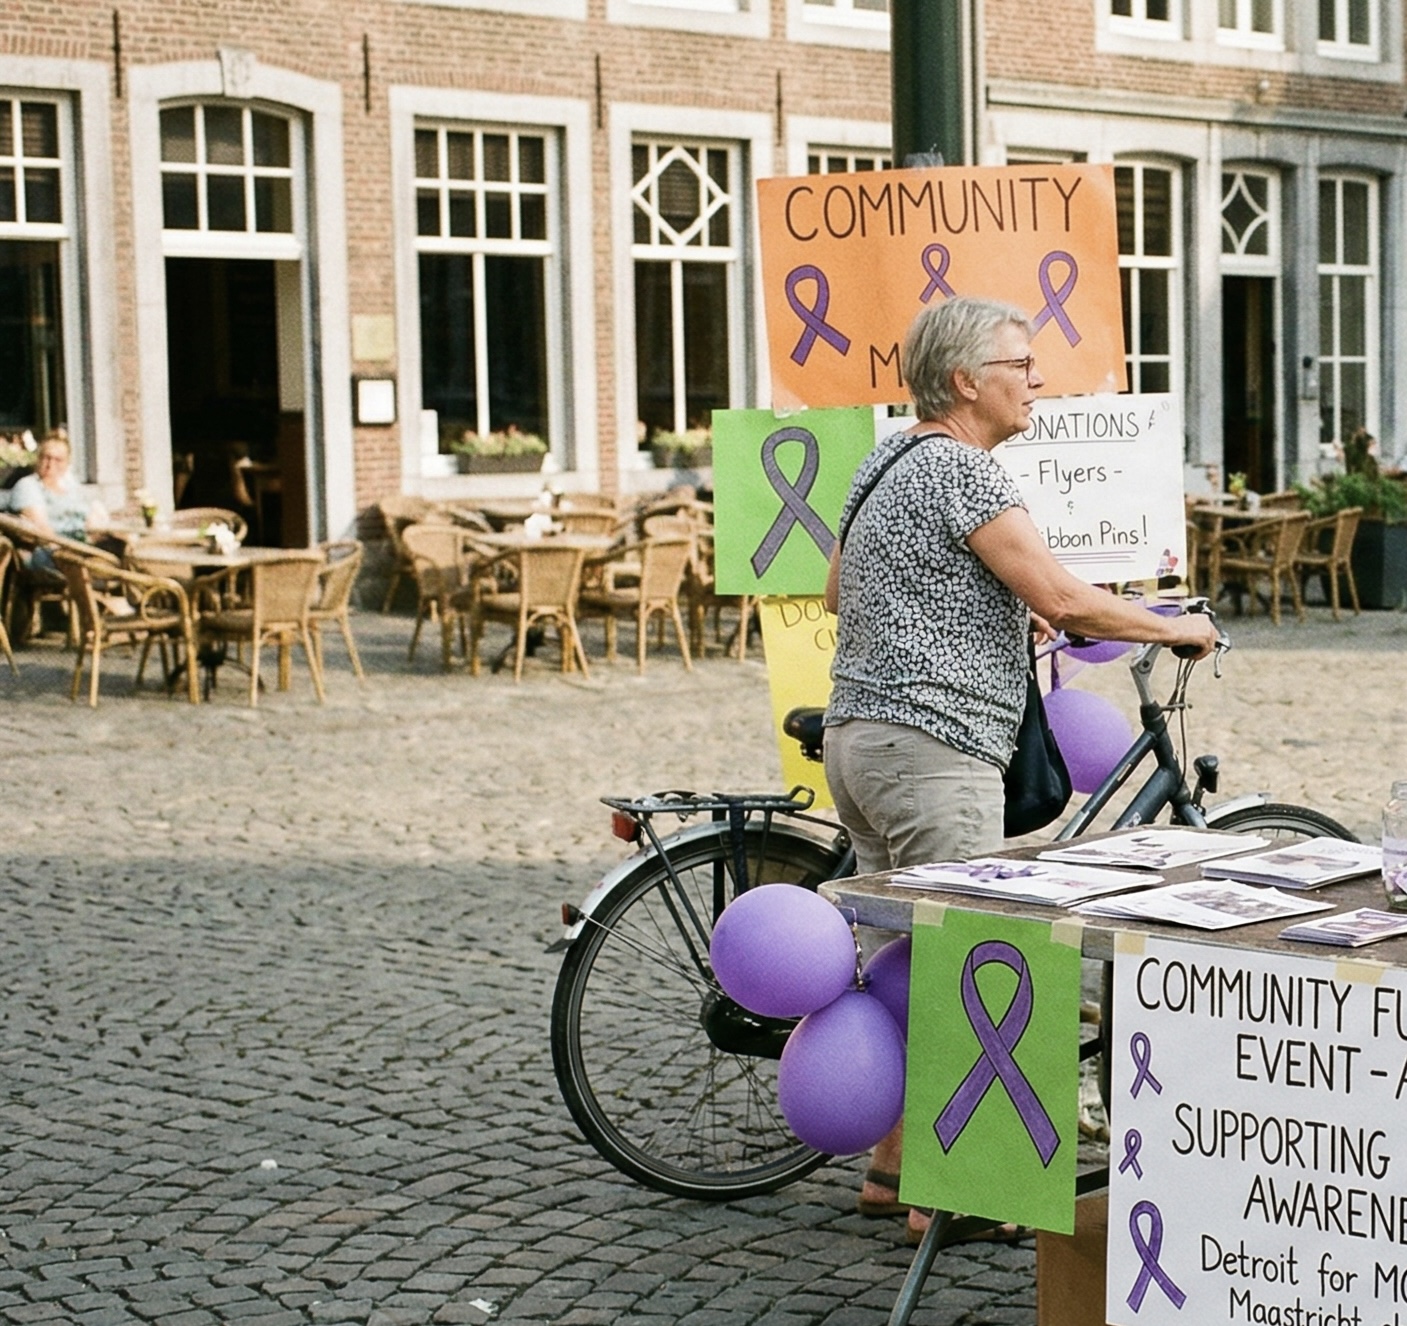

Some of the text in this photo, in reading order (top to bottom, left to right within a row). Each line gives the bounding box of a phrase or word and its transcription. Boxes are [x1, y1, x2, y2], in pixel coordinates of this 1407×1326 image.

[784, 176, 1083, 242] COMMUNITY
[1005, 411, 1140, 443] ONATIONS
[1039, 458, 1107, 495] Flyers
[1099, 514, 1149, 547] Pins!
[1136, 957, 1352, 1033] COMMUNITY
[1236, 1034, 1362, 1094] EVENT
[1171, 1103, 1391, 1180] SUPPORTING
[1200, 1234, 1299, 1286] Detroit
[1317, 1252, 1359, 1298] for
